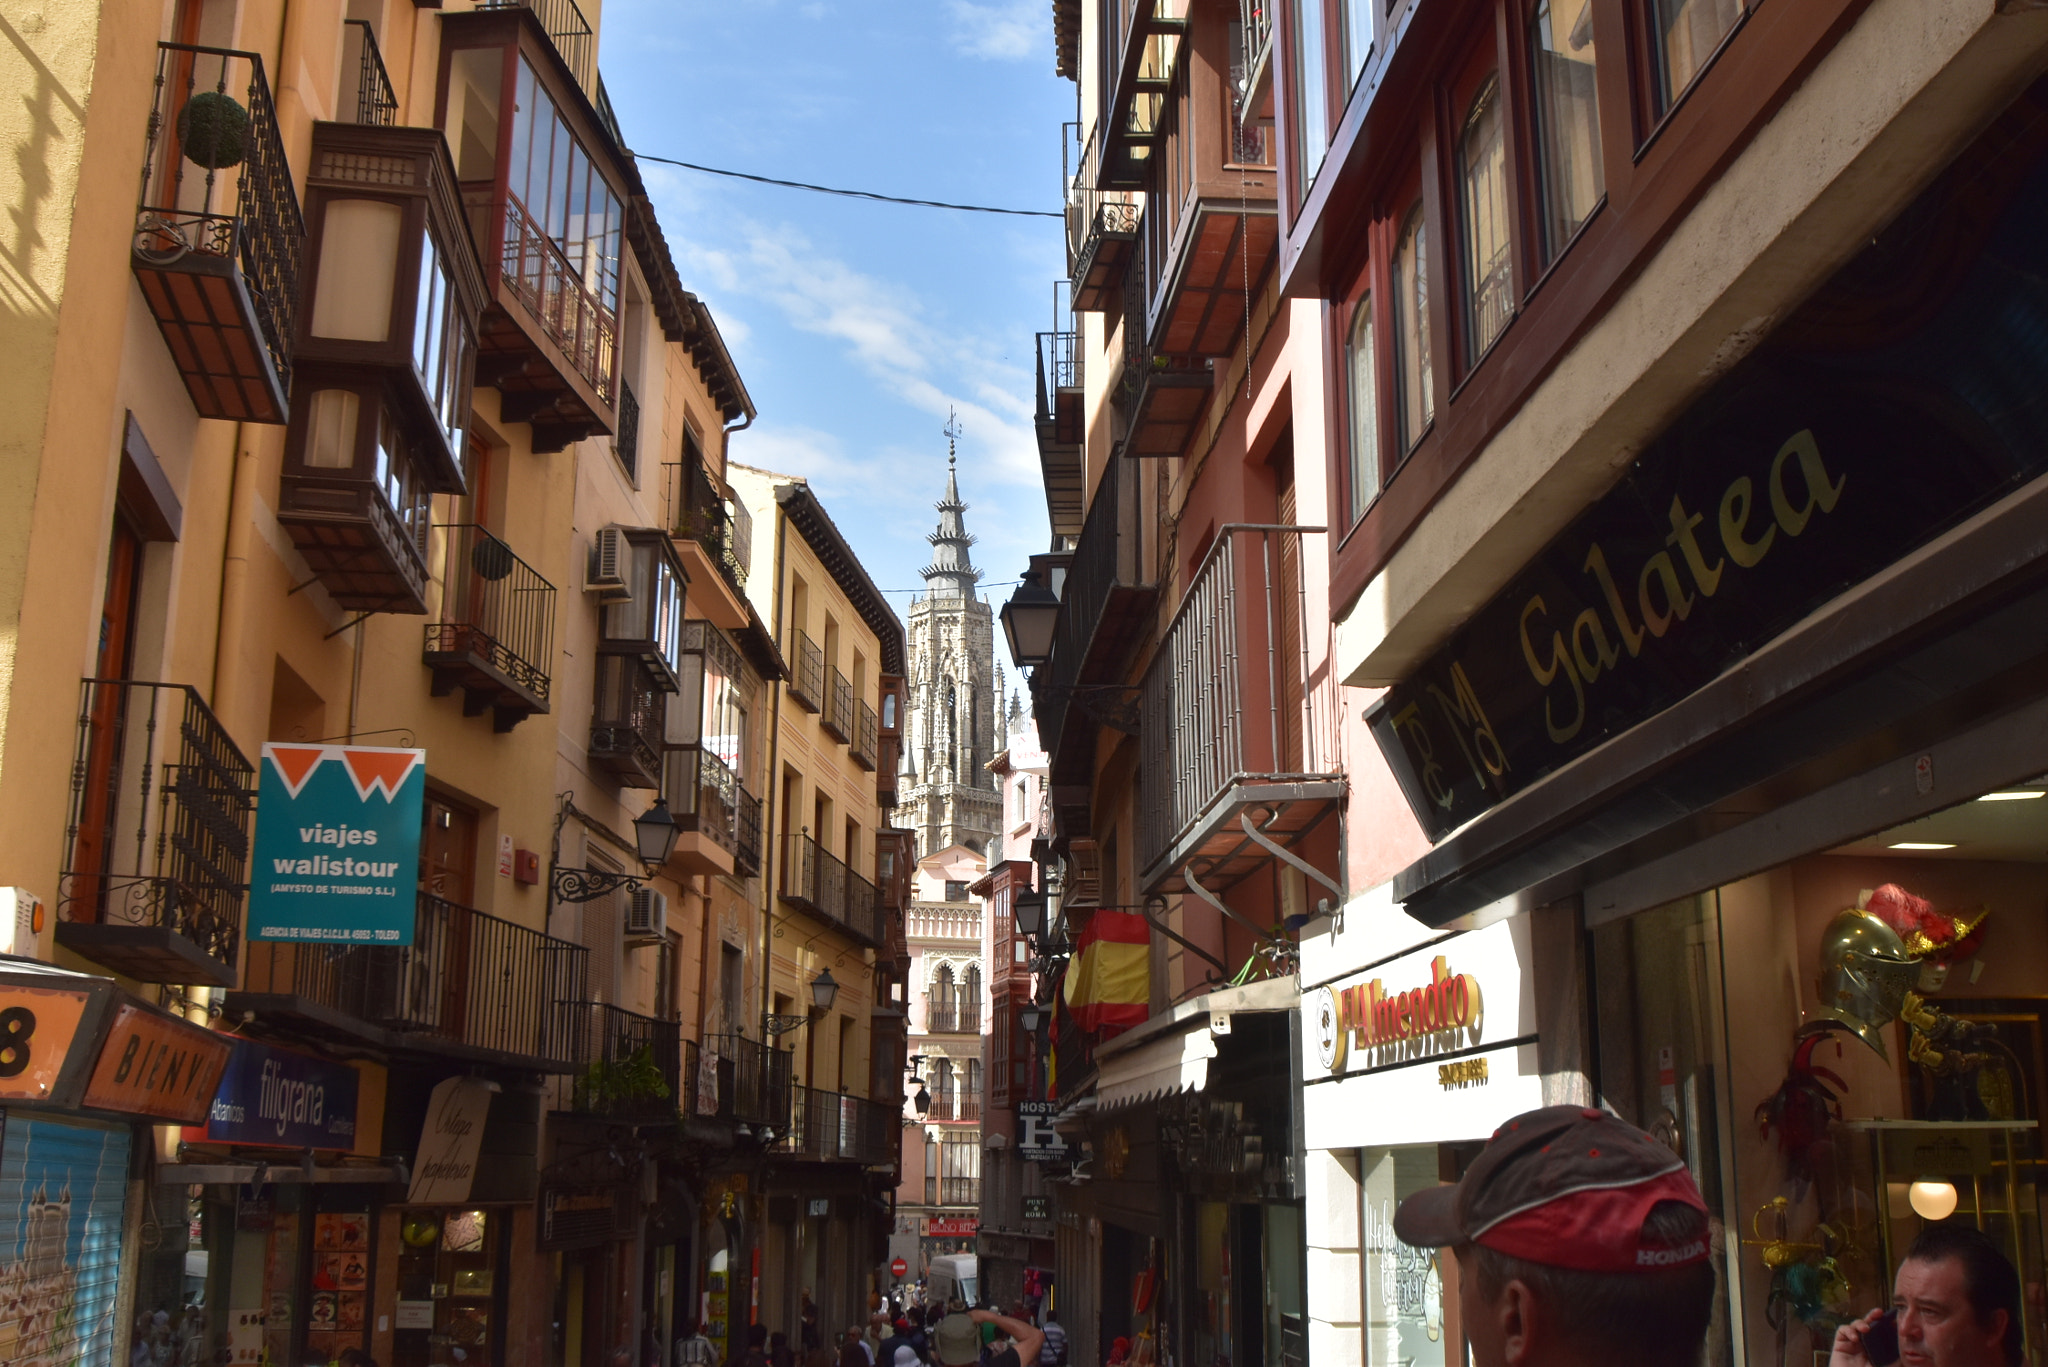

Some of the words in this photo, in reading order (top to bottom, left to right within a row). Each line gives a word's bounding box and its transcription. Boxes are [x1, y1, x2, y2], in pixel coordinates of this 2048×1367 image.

[1520, 428, 1847, 745] Galatea
[299, 823, 378, 848] viajes
[273, 855, 398, 878] walistour
[270, 884, 314, 894] (AMYSTO
[315, 885, 329, 894] DE
[331, 886, 373, 895] TURISMO
[375, 887, 396, 897] S.L.)
[260, 927, 289, 937] AGENCIA
[290, 928, 299, 937] DE
[300, 928, 322, 938] VIAJES
[375, 930, 400, 940] TOLEDO
[1355, 955, 1479, 1051] Almendro
[210, 1097, 245, 1124] Abanicos
[258, 1057, 324, 1137] filigrana
[1020, 1101, 1055, 1113] HOST
[930, 1223, 957, 1233] BRUNO
[1635, 1240, 1706, 1266] HONDA
